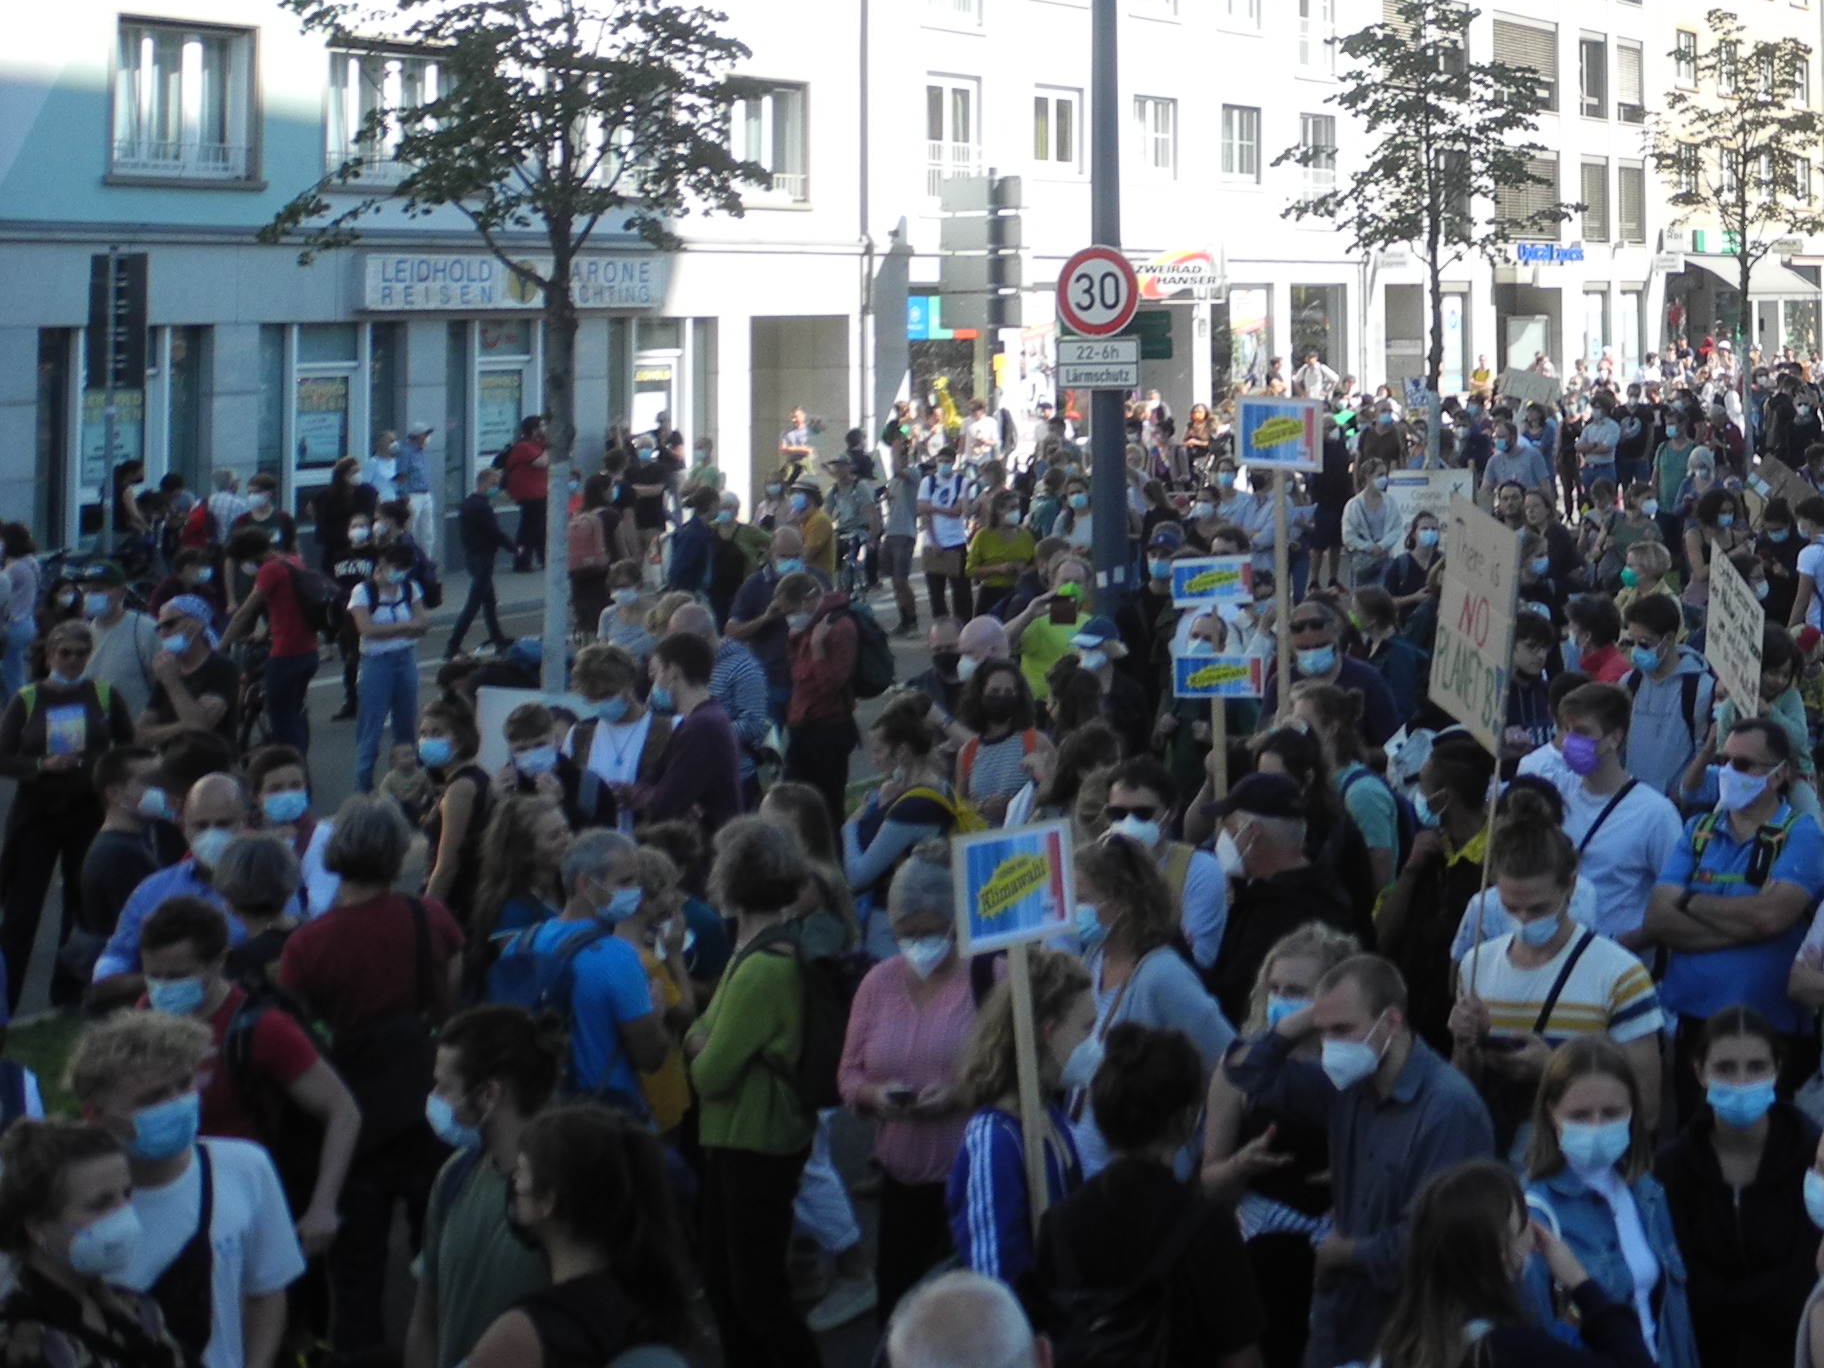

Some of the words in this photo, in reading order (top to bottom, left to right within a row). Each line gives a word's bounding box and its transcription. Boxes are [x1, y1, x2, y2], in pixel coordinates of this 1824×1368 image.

[381, 258, 493, 283] LEIDHOLD
[569, 261, 651, 283] ARONE
[1135, 264, 1202, 275] ZWEIRAD
[1156, 274, 1217, 285] HANSER
[380, 285, 493, 306] REISEN
[1073, 271, 1120, 312] 30
[1075, 345, 1120, 361] 22-6h
[1065, 367, 1130, 384] Lärmschutz
[1457, 590, 1491, 649] NO
[1434, 624, 1483, 712] PLANET
[979, 856, 1047, 915] Klimawahl
